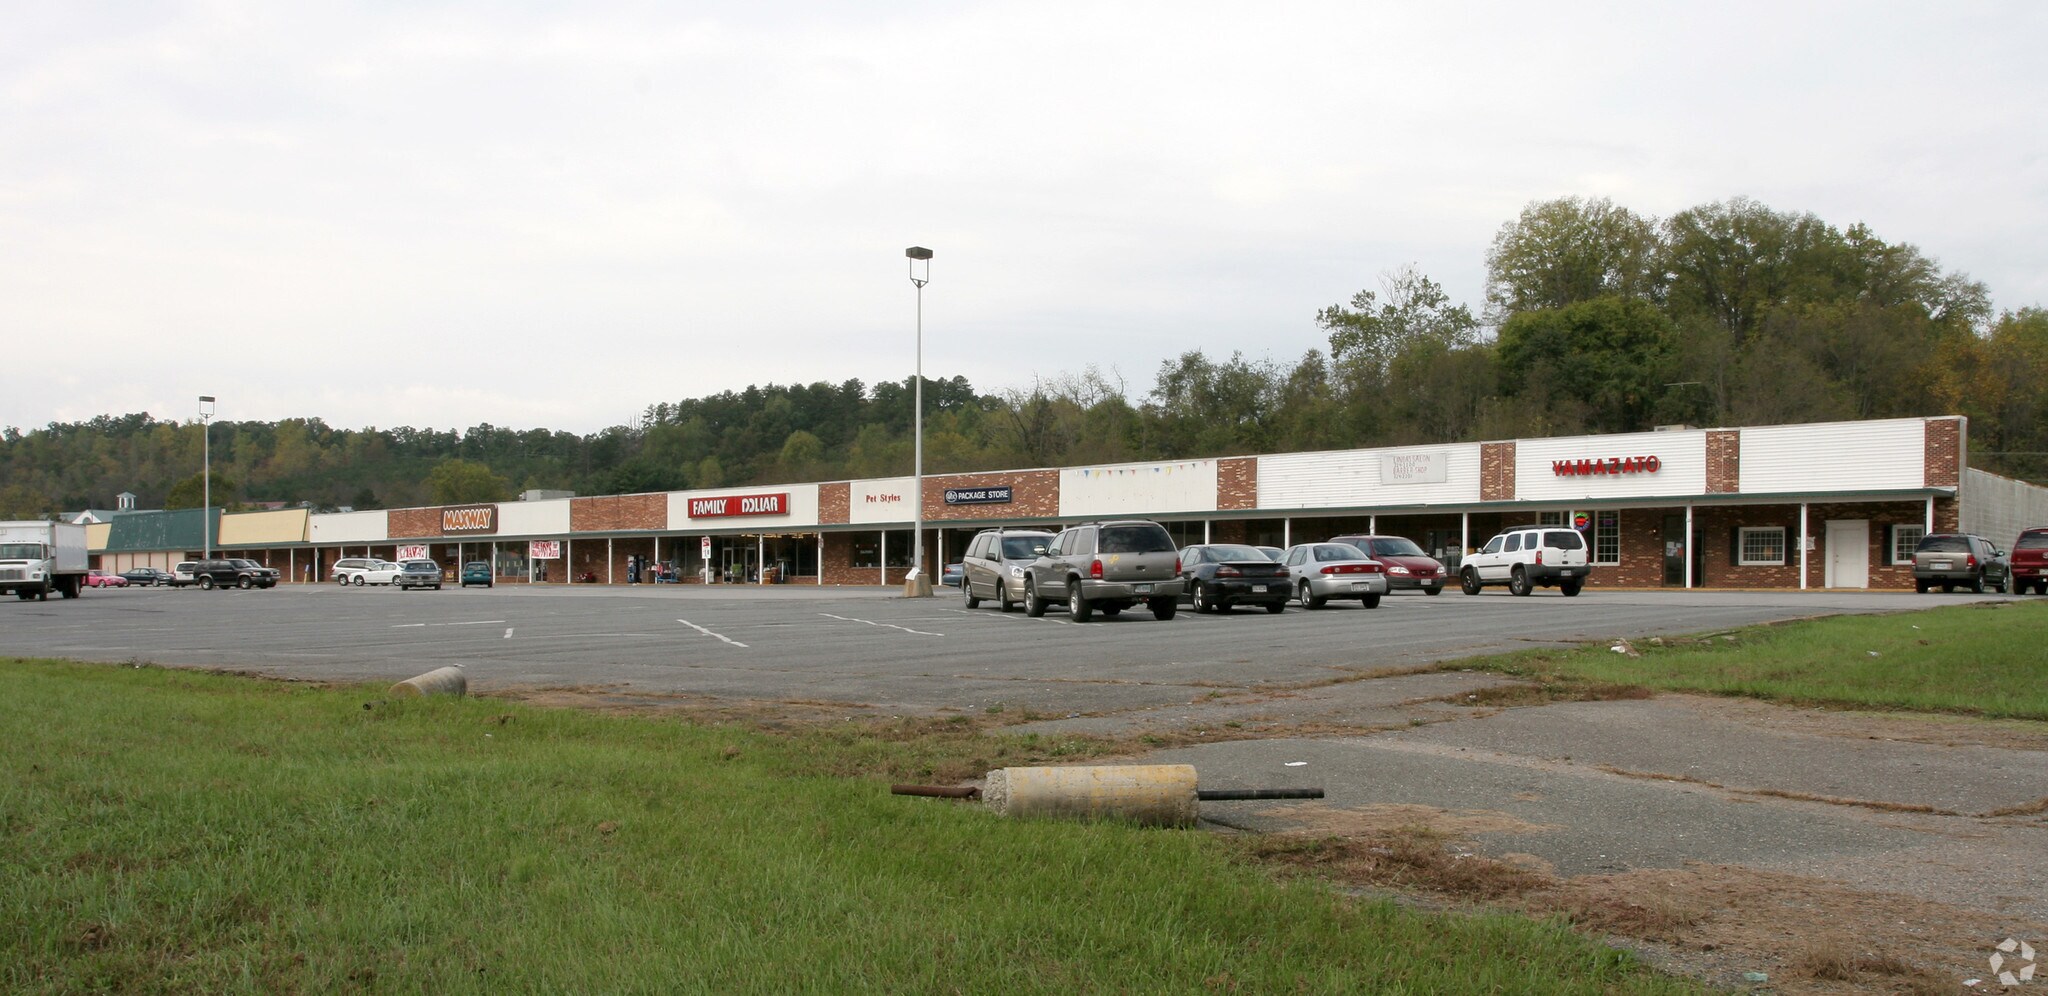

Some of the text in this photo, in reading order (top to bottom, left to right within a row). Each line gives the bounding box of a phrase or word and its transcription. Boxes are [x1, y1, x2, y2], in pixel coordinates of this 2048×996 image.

[1552, 455, 1660, 477] YAMAZATO
[865, 493, 901, 504] Pet Styles
[958, 491, 986, 499] PACKAGE
[988, 490, 1008, 498] STORE
[692, 496, 778, 516] FAMILY DOLLAR
[443, 508, 492, 531] MAXWAY
